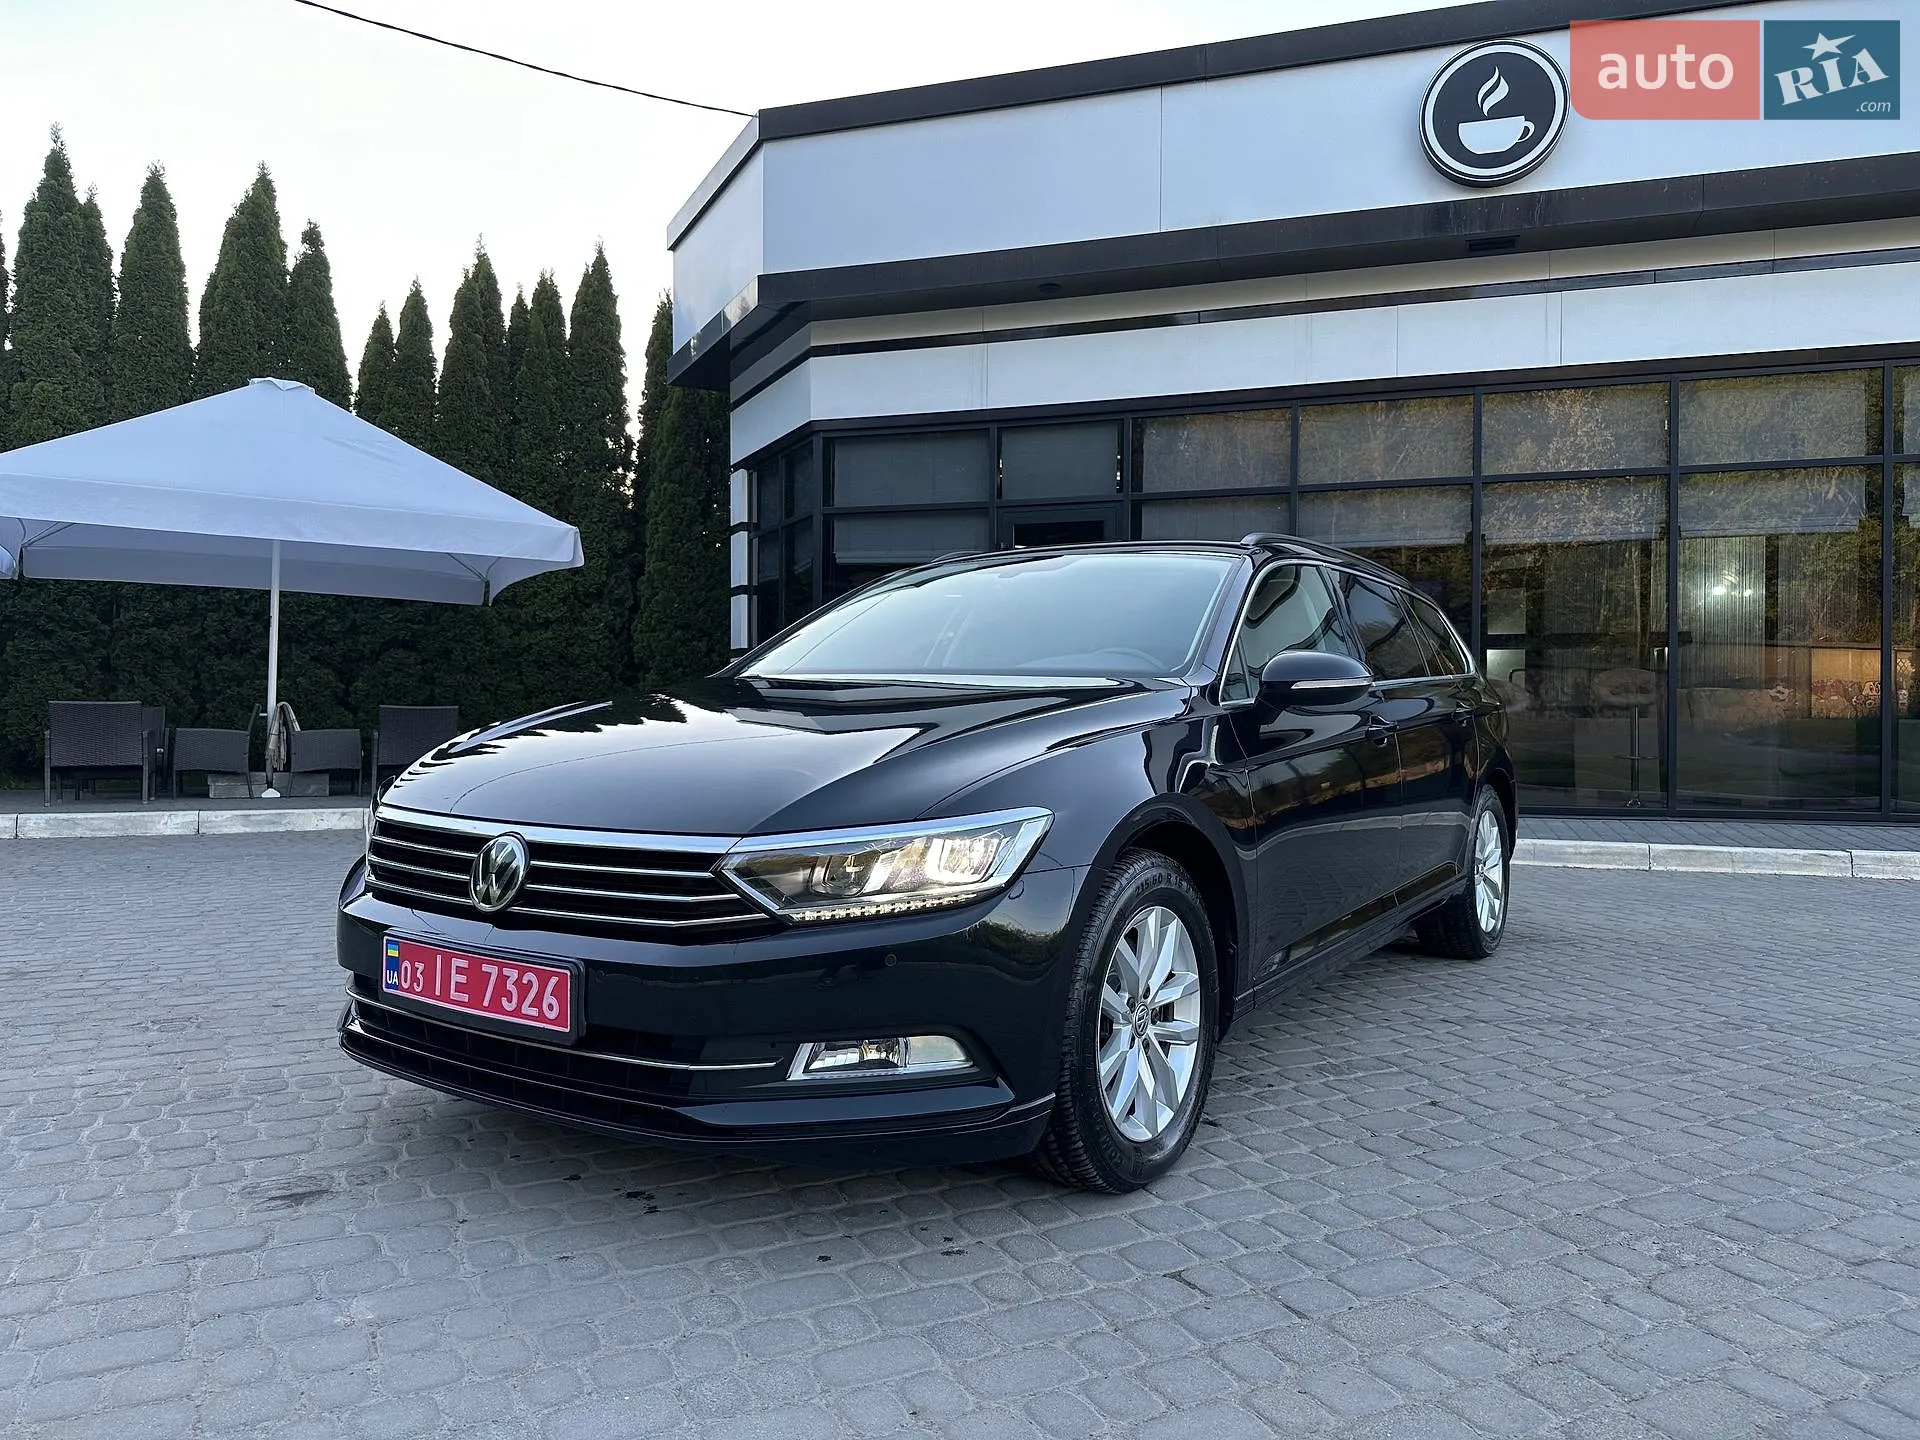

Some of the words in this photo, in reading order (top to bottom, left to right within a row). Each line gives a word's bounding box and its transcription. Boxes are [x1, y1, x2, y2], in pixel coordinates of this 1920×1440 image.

[386, 970, 399, 985] UA
[401, 960, 424, 992] 03
[435, 955, 469, 1002] IE
[482, 964, 560, 1020] 7326
